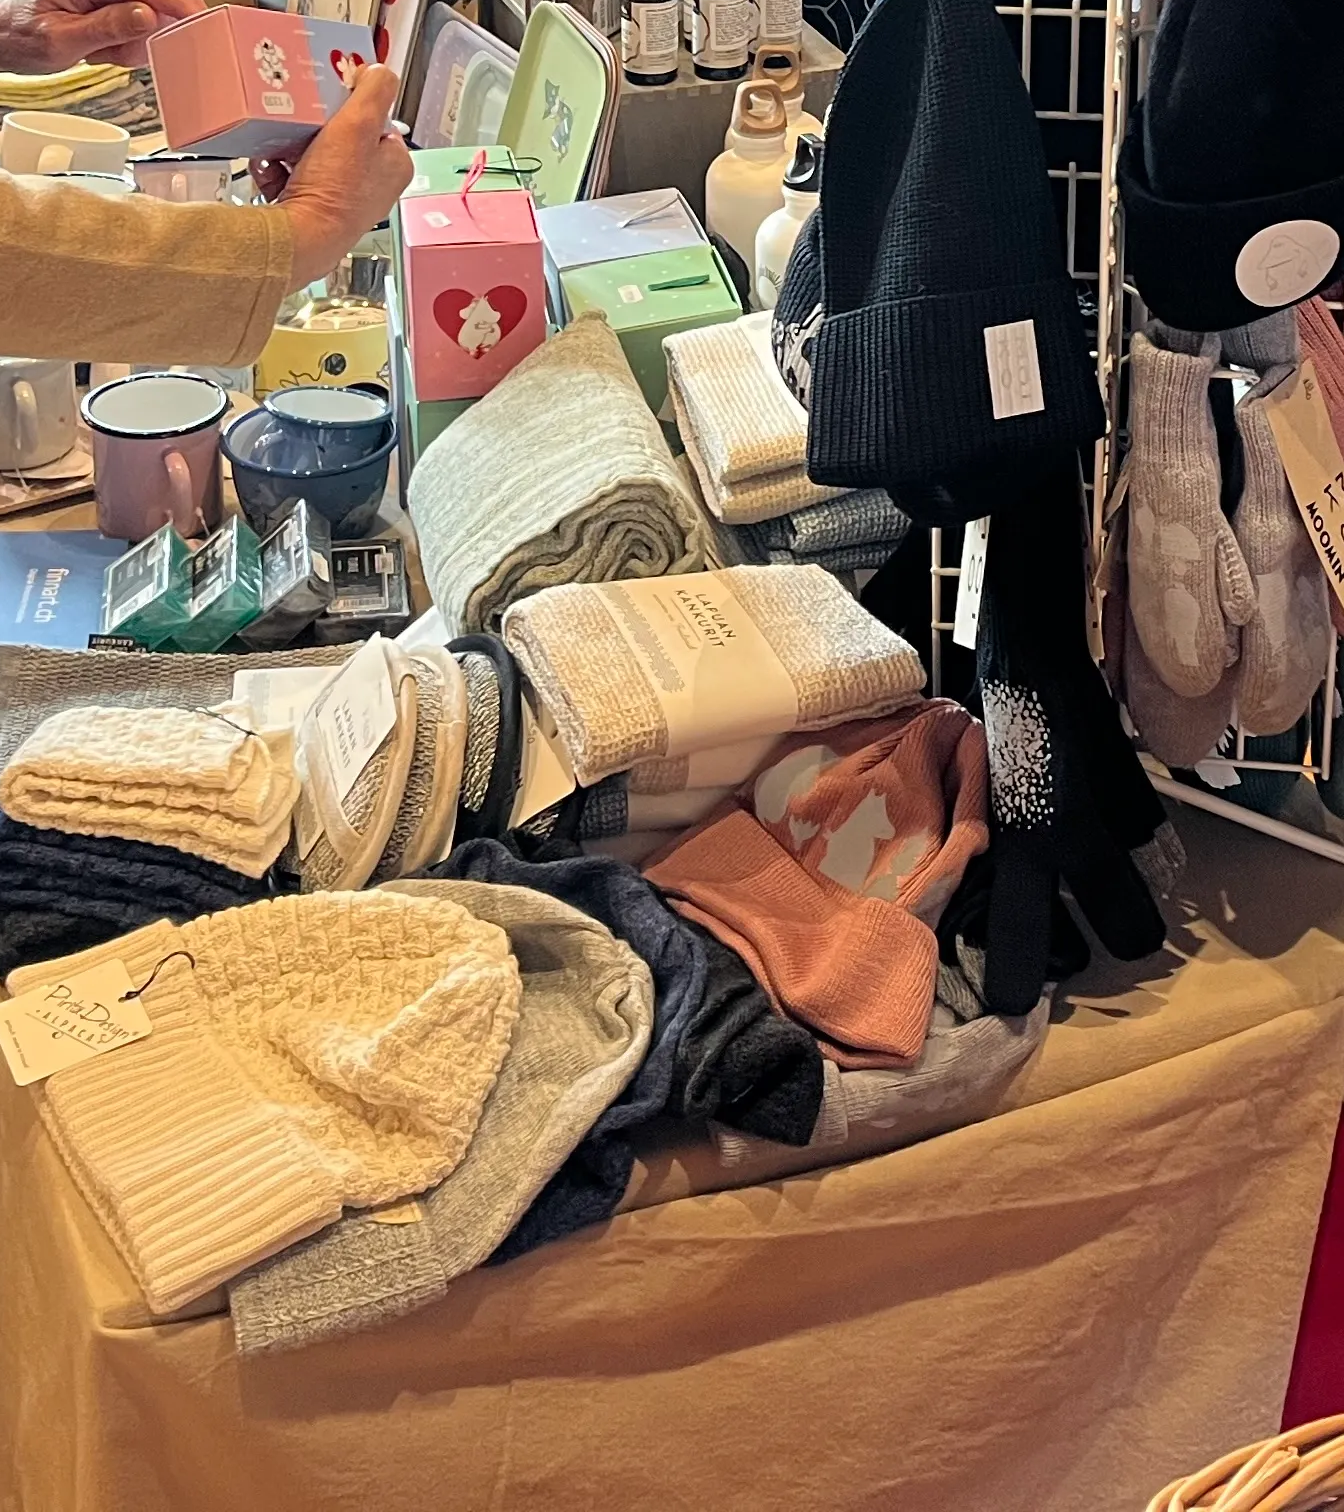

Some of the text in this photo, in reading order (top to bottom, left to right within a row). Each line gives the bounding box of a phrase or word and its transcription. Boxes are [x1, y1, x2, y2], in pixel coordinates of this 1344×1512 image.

[33, 567, 70, 624] finnart.ch
[675, 589, 726, 648] KANKURIT
[694, 593, 737, 639] LAPUAN
[333, 704, 351, 768] KANKURIT
[342, 699, 357, 751] LAPUAN
[42, 1010, 96, 1043] ALPACA
